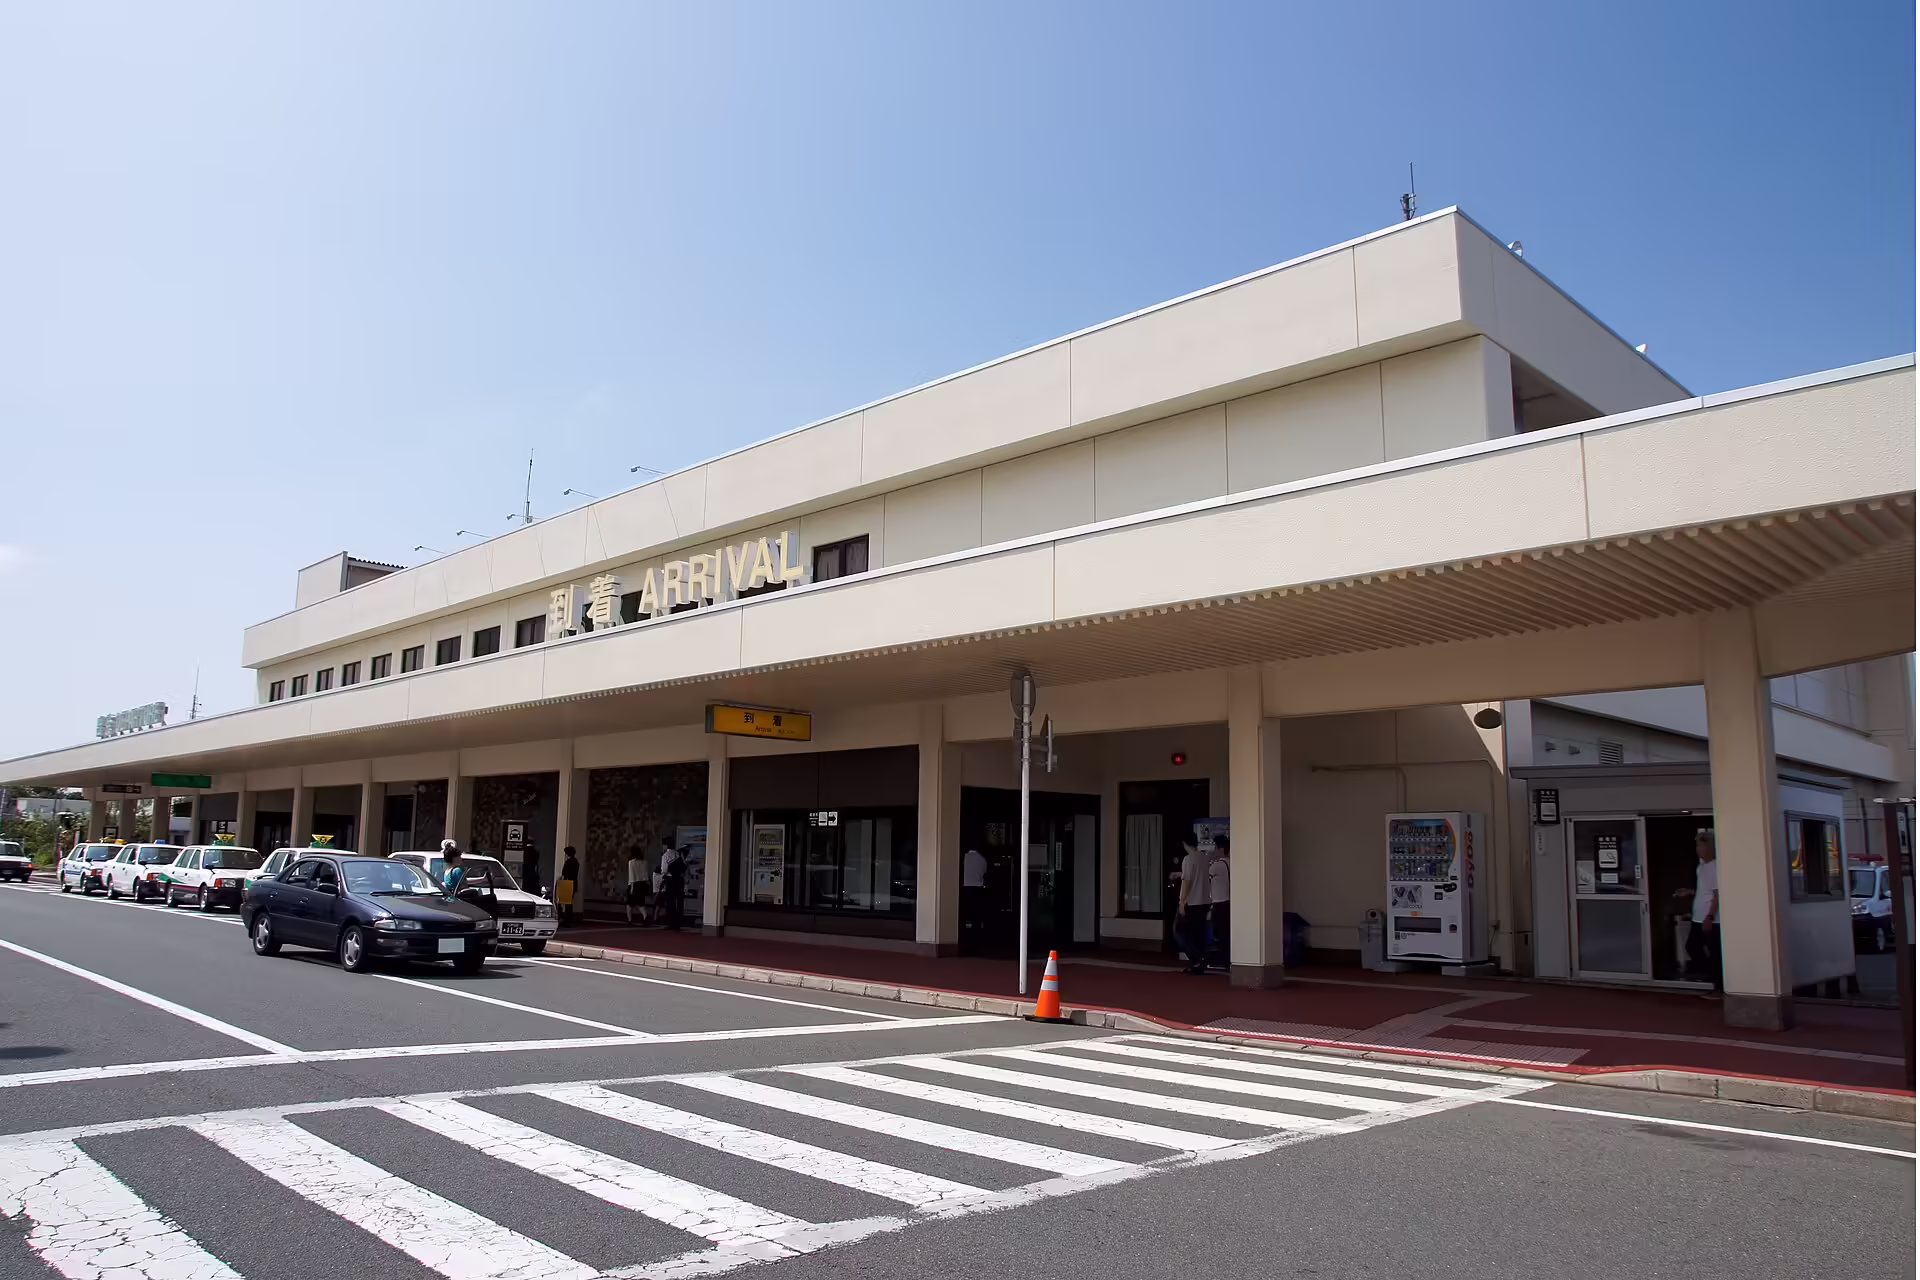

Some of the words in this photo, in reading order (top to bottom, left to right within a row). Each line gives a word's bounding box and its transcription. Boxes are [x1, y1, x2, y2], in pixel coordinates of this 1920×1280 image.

[549, 573, 621, 634] 到着
[638, 531, 804, 614] ARRIVAL
[744, 712, 783, 727] 到着
